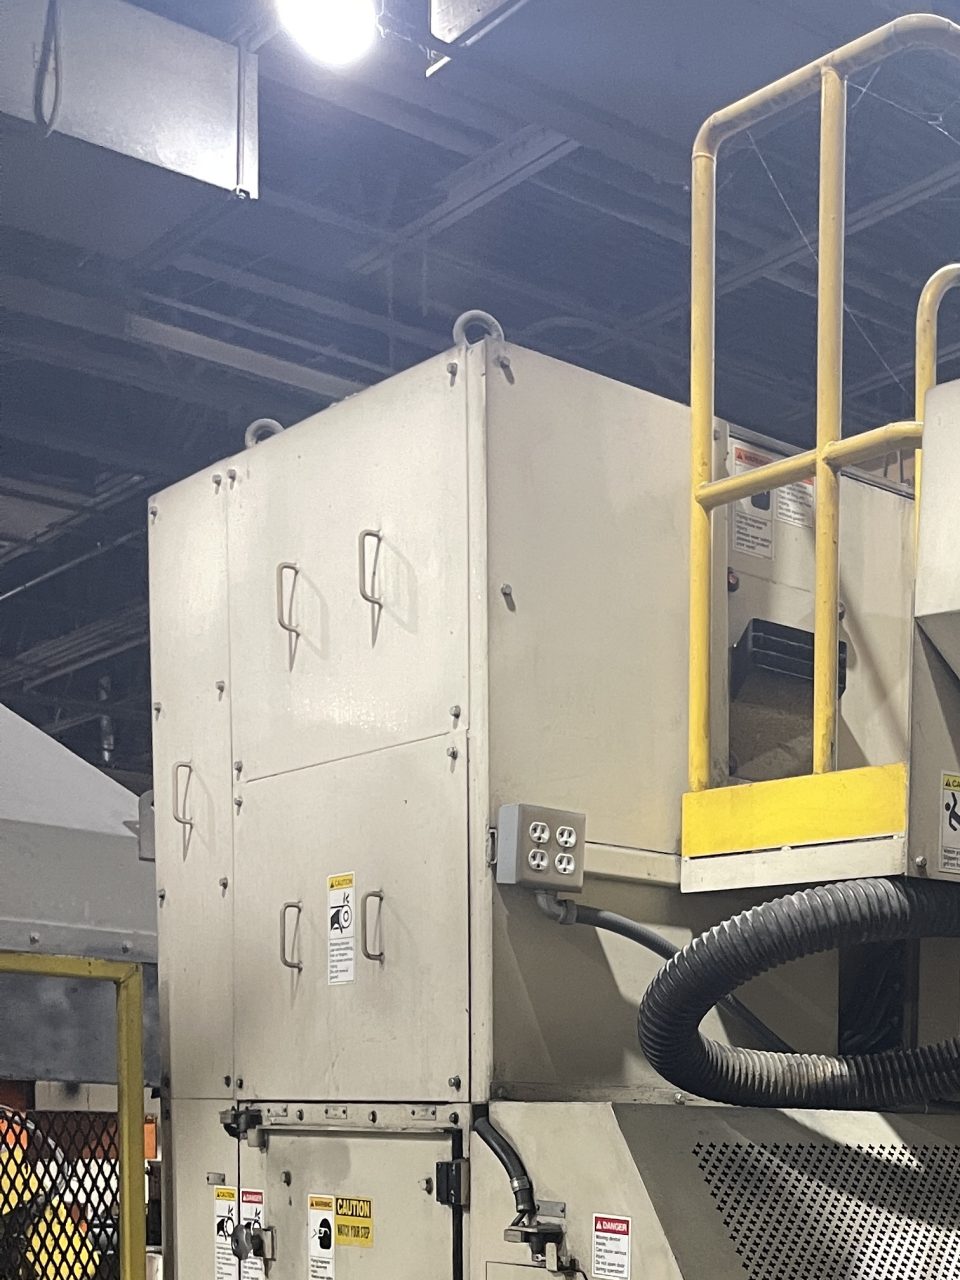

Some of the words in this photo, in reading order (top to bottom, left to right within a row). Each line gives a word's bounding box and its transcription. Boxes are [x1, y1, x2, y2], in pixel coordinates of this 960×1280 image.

[337, 1199, 371, 1217] CAUTION
[337, 1224, 350, 1237] WATCH
[351, 1225, 361, 1239] YOUR
[361, 1226, 371, 1240] STEP
[602, 1221, 628, 1232] DANGER
